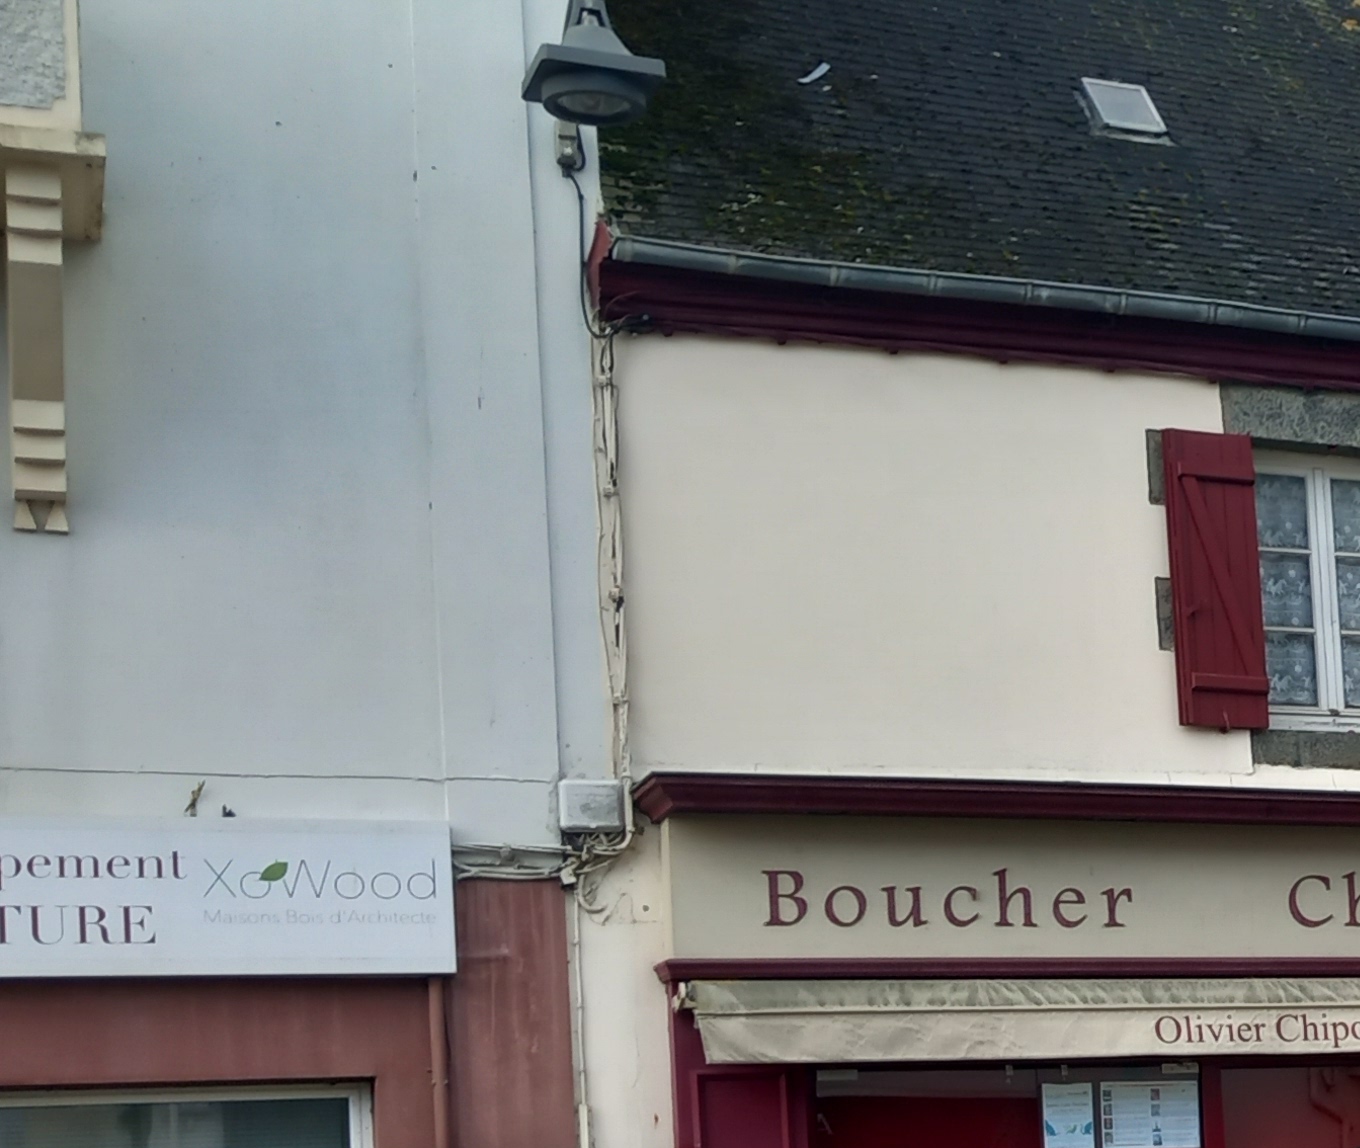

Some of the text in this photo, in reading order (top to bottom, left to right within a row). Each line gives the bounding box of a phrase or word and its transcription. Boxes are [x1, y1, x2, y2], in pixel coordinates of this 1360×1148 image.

[0, 850, 188, 892] pement
[203, 908, 437, 925] Maisons Bois d'Architecte
[762, 867, 1135, 930] Boucher
[0, 904, 156, 945] TURE
[1154, 1012, 1267, 1045] Olivier
